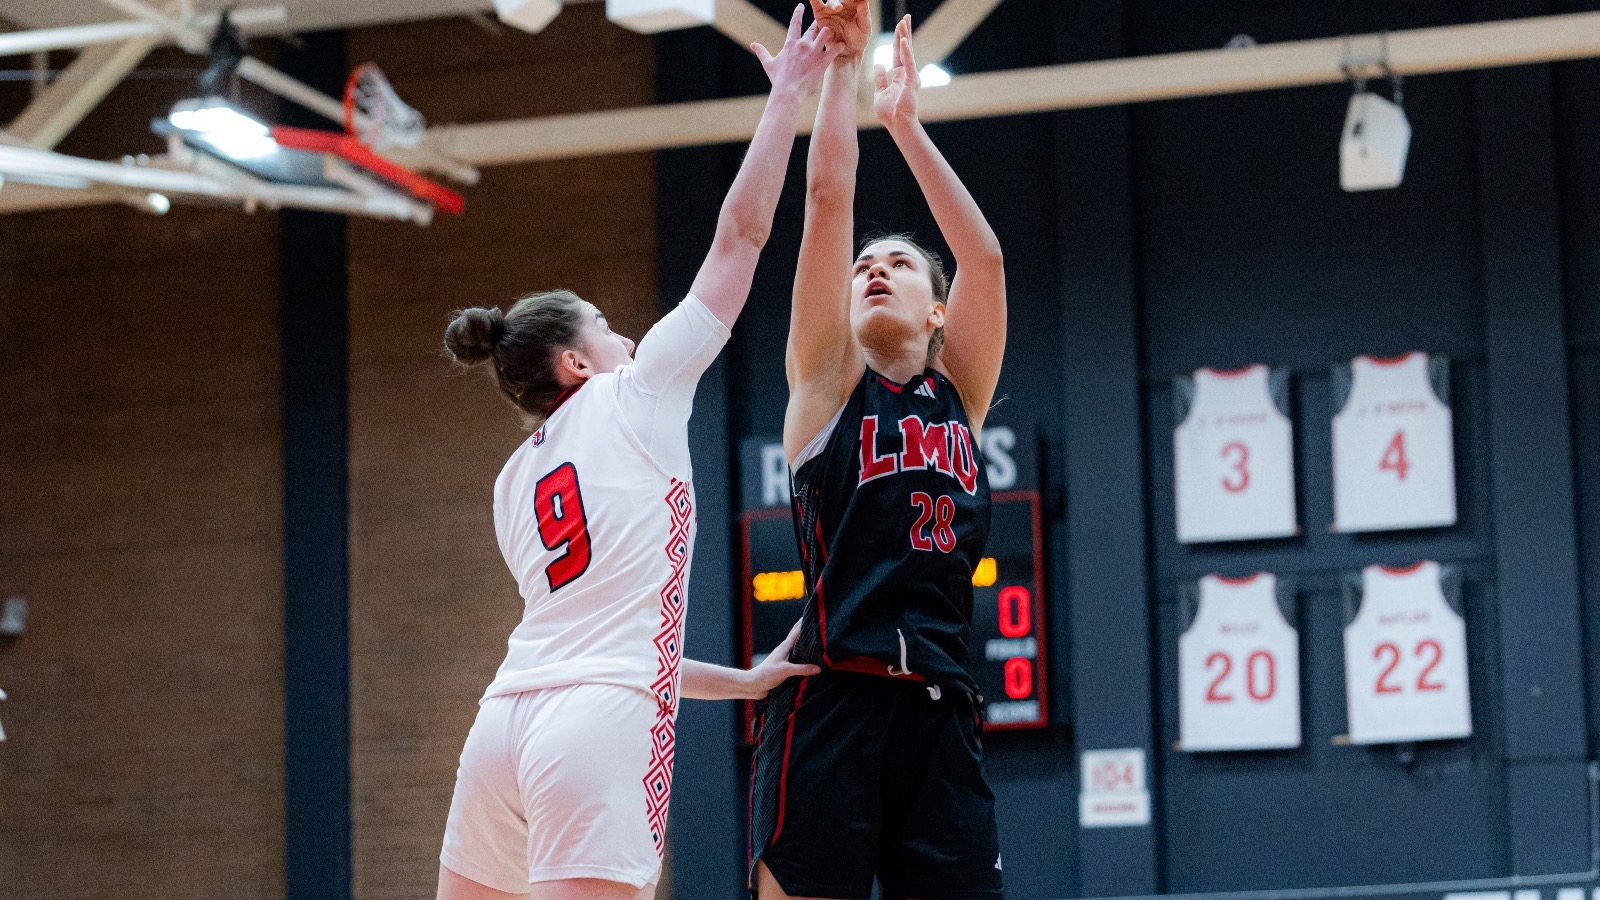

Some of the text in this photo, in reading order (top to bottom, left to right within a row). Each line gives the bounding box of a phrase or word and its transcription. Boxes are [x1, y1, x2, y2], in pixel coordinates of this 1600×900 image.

[857, 415, 978, 495] LMU
[1220, 440, 1250, 494] 3
[1378, 430, 1410, 482] 4
[533, 461, 592, 593] 9
[910, 492, 956, 553] 28
[998, 585, 1031, 638] 0
[1004, 657, 1032, 699] 0
[1205, 650, 1276, 703] 20
[1372, 639, 1444, 694] 22
